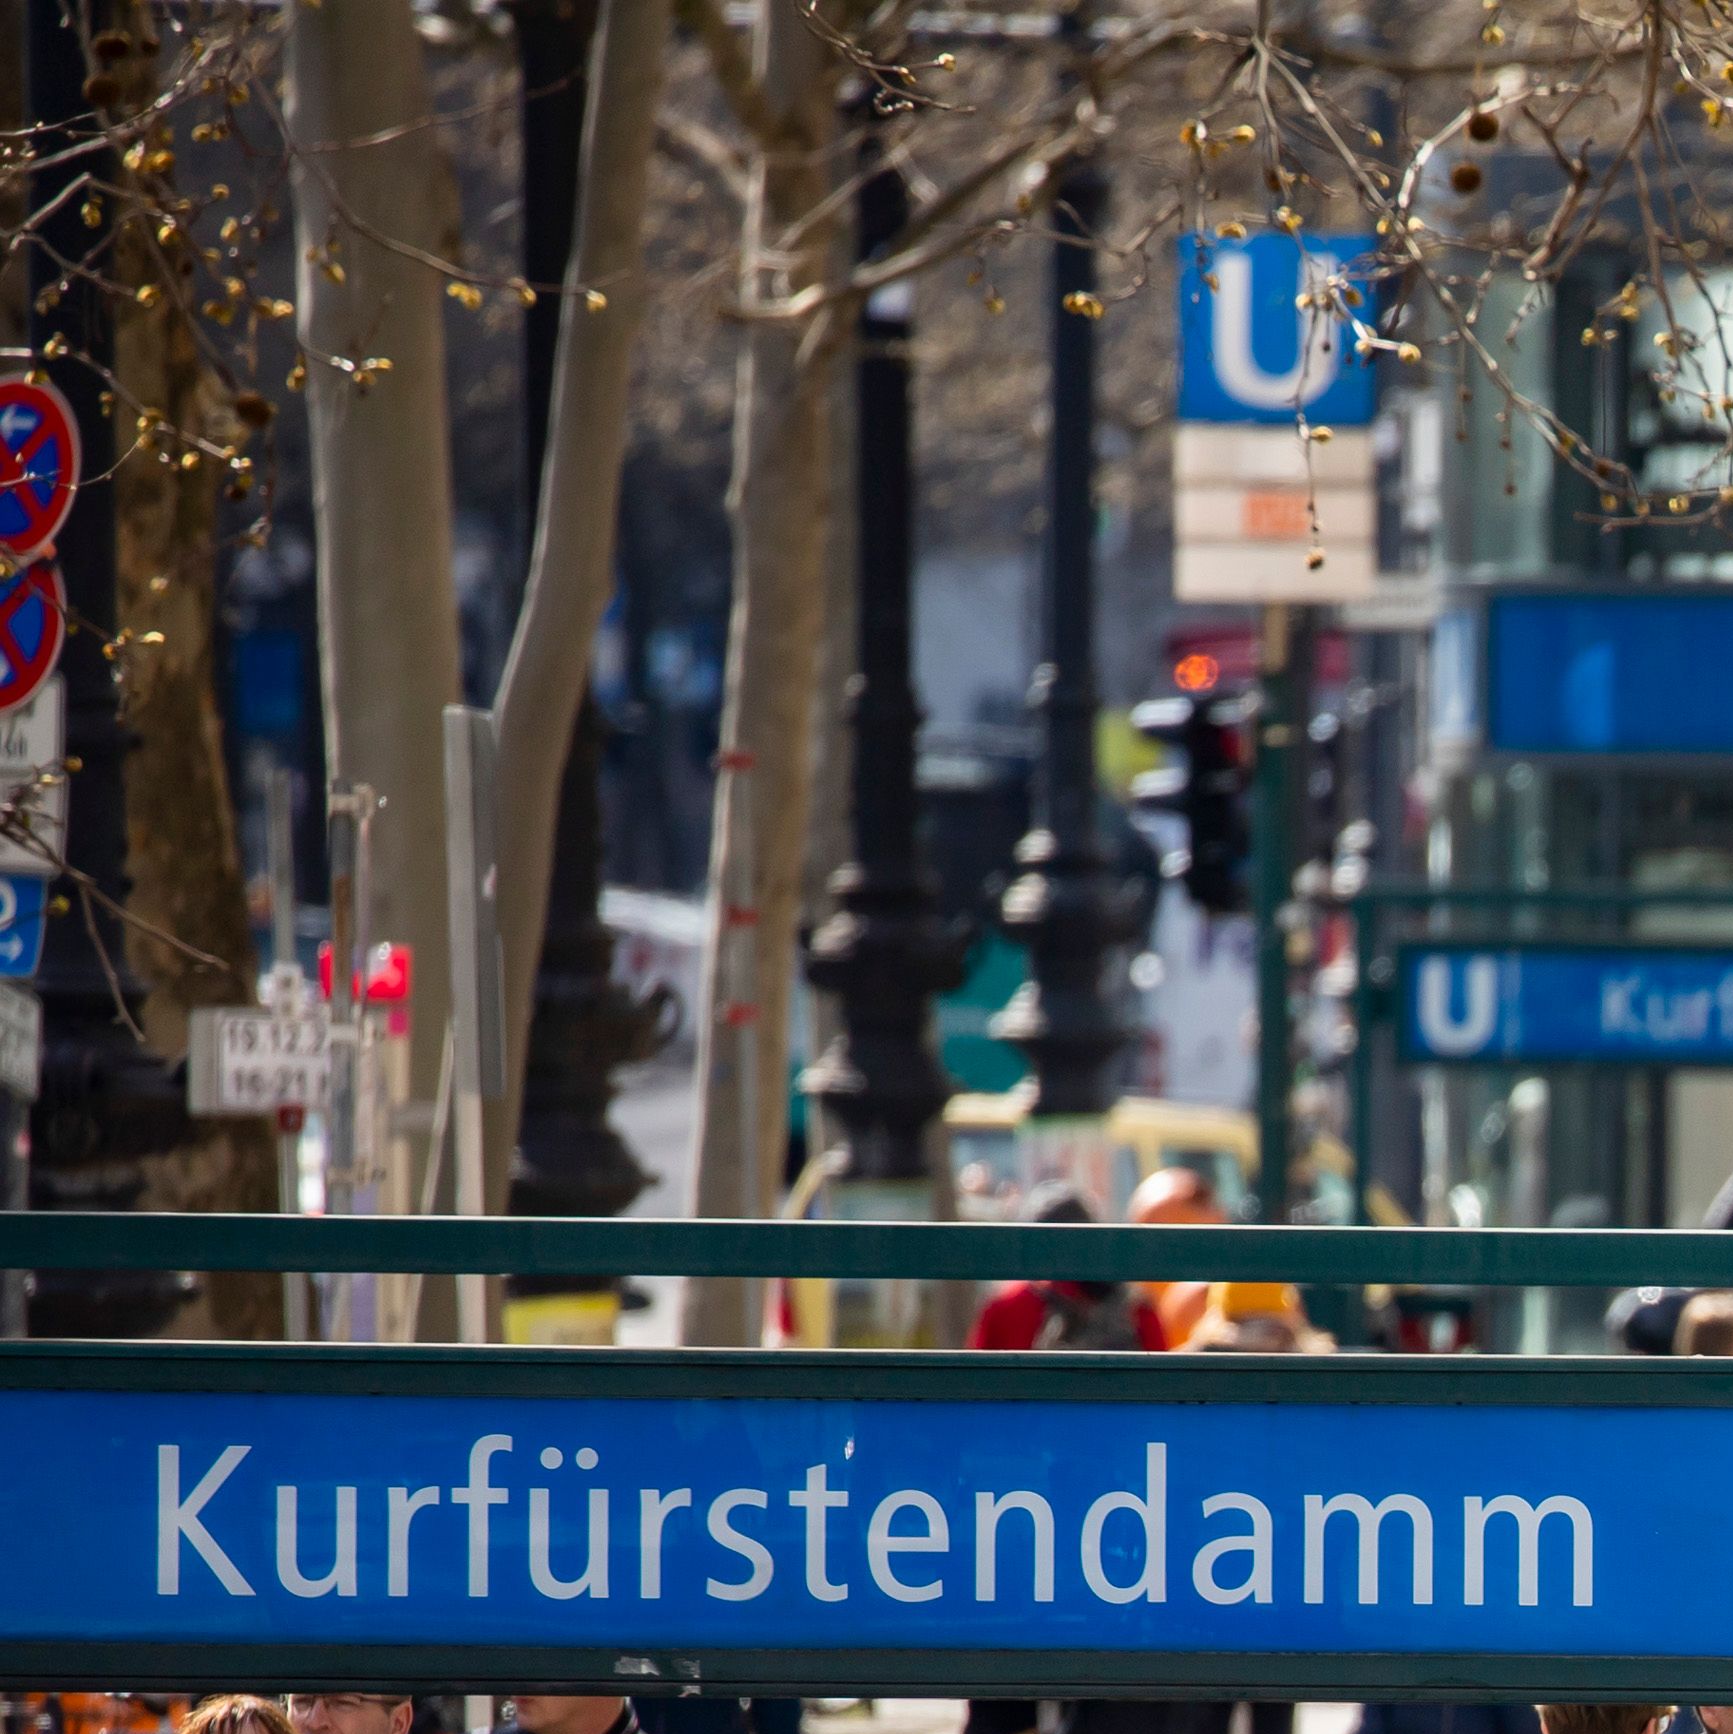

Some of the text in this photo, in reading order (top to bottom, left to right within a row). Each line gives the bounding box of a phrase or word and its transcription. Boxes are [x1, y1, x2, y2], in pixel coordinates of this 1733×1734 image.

[1211, 253, 1341, 411] U
[1417, 953, 1498, 1056] U
[157, 1433, 1594, 1606] Kurfürstendamm
